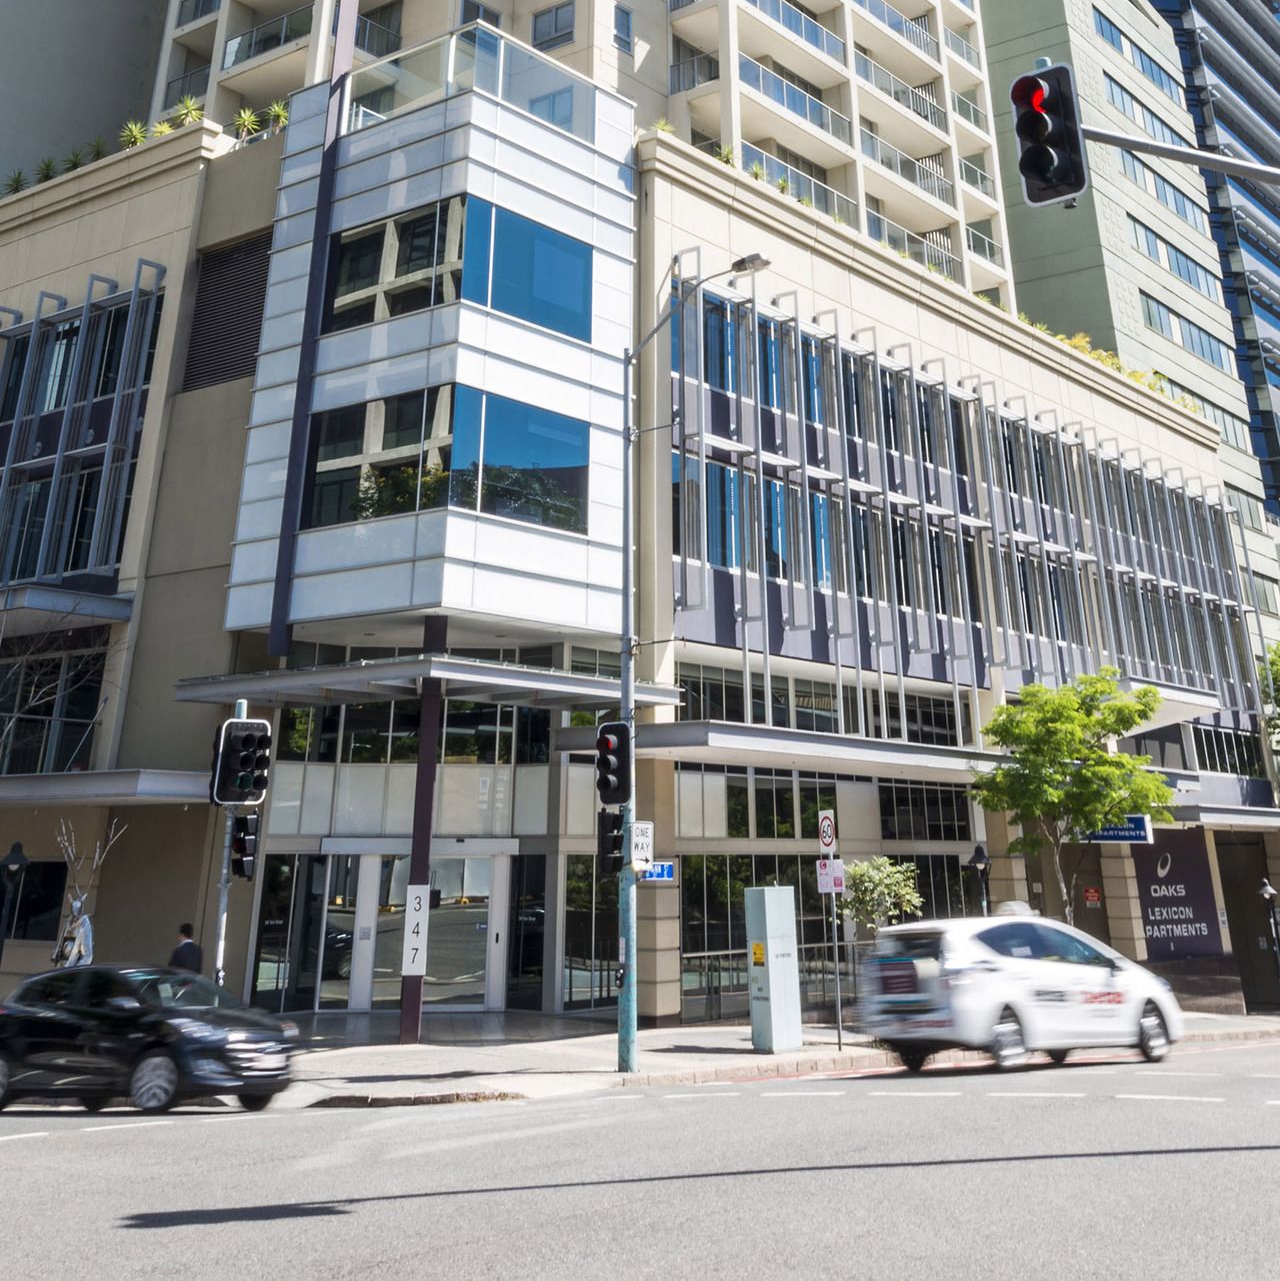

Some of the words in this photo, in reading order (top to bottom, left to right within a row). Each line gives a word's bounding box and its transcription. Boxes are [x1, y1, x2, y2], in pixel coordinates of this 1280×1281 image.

[635, 827, 649, 838] ONE
[823, 824, 832, 839] 60
[634, 841, 650, 853] WAY
[1150, 884, 1186, 897] OAKS
[1148, 906, 1194, 920] LEXICON
[1145, 923, 1209, 939] PARTMENTS
